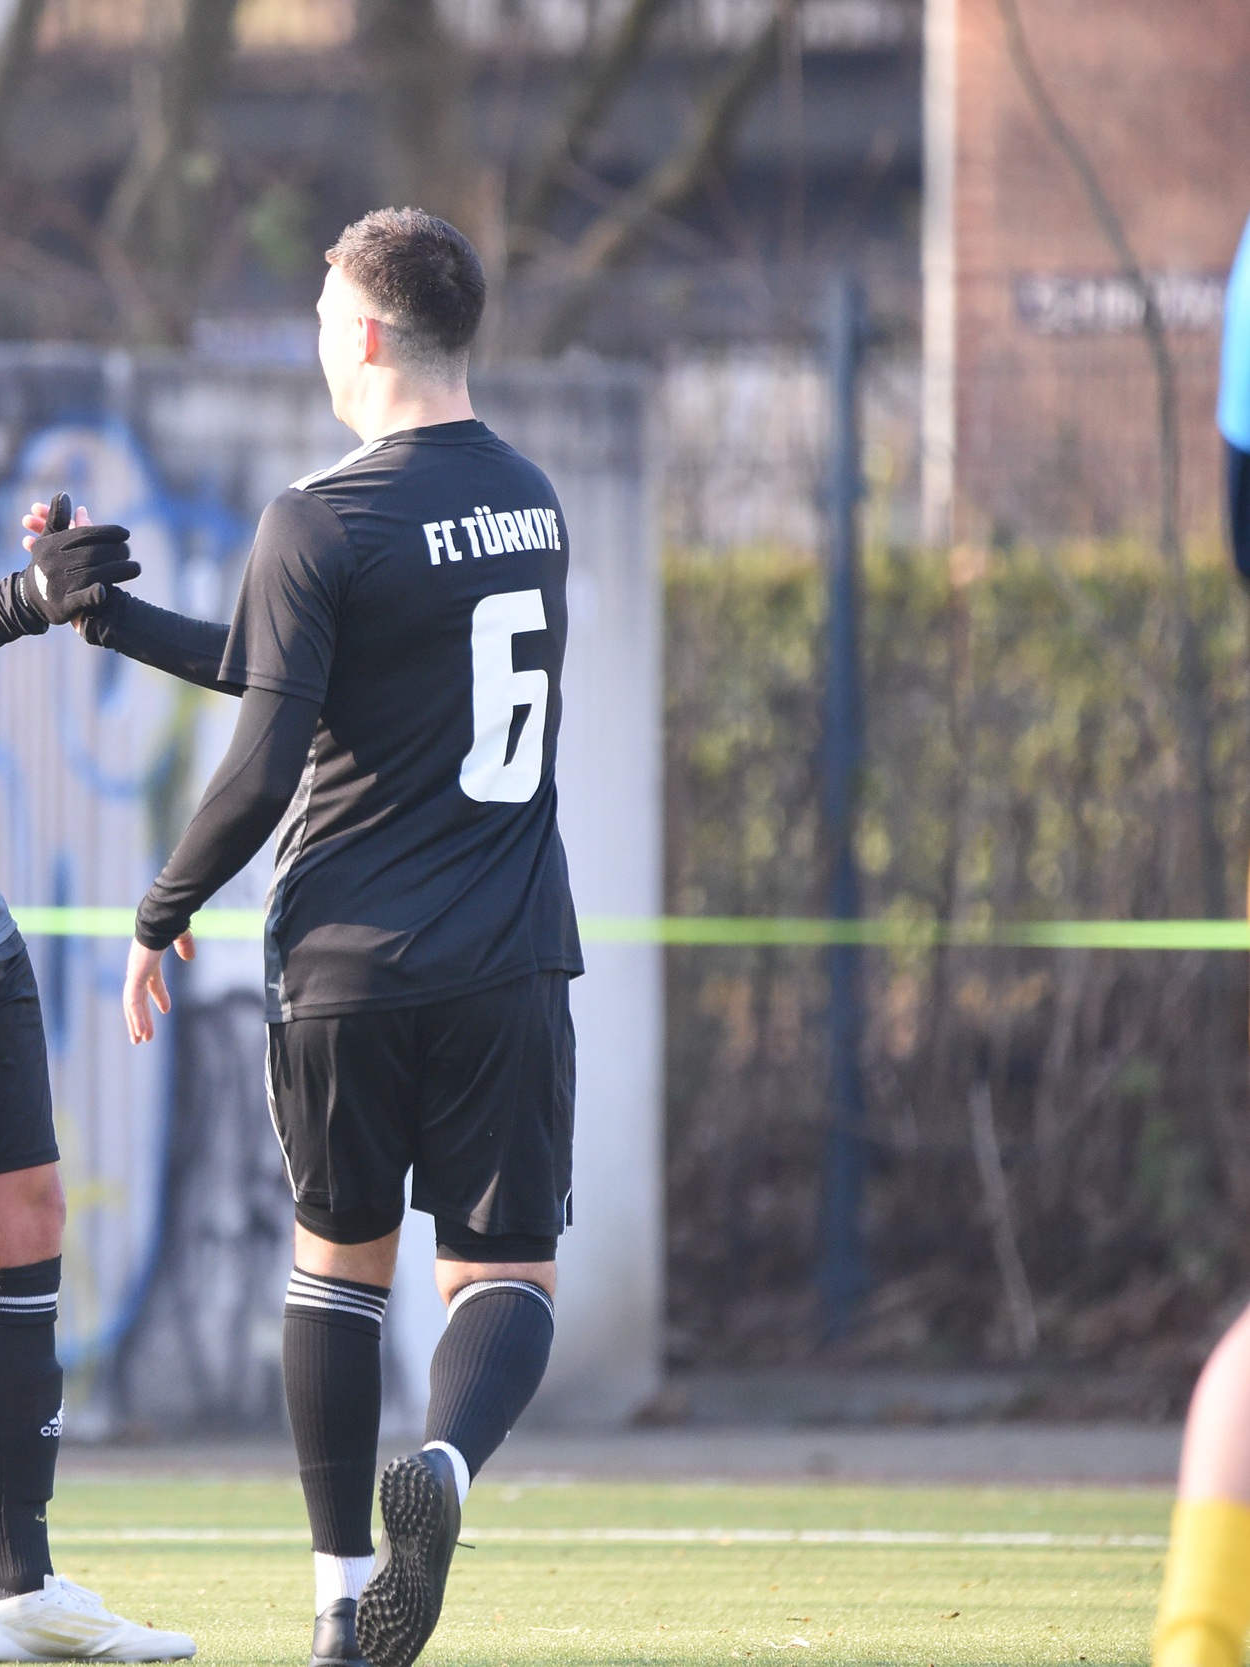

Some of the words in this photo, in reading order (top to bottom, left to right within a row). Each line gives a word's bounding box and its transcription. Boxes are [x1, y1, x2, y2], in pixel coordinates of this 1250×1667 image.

[422, 519, 463, 566] FC
[460, 505, 561, 558] TÜRKIYE
[459, 588, 549, 804] 6
